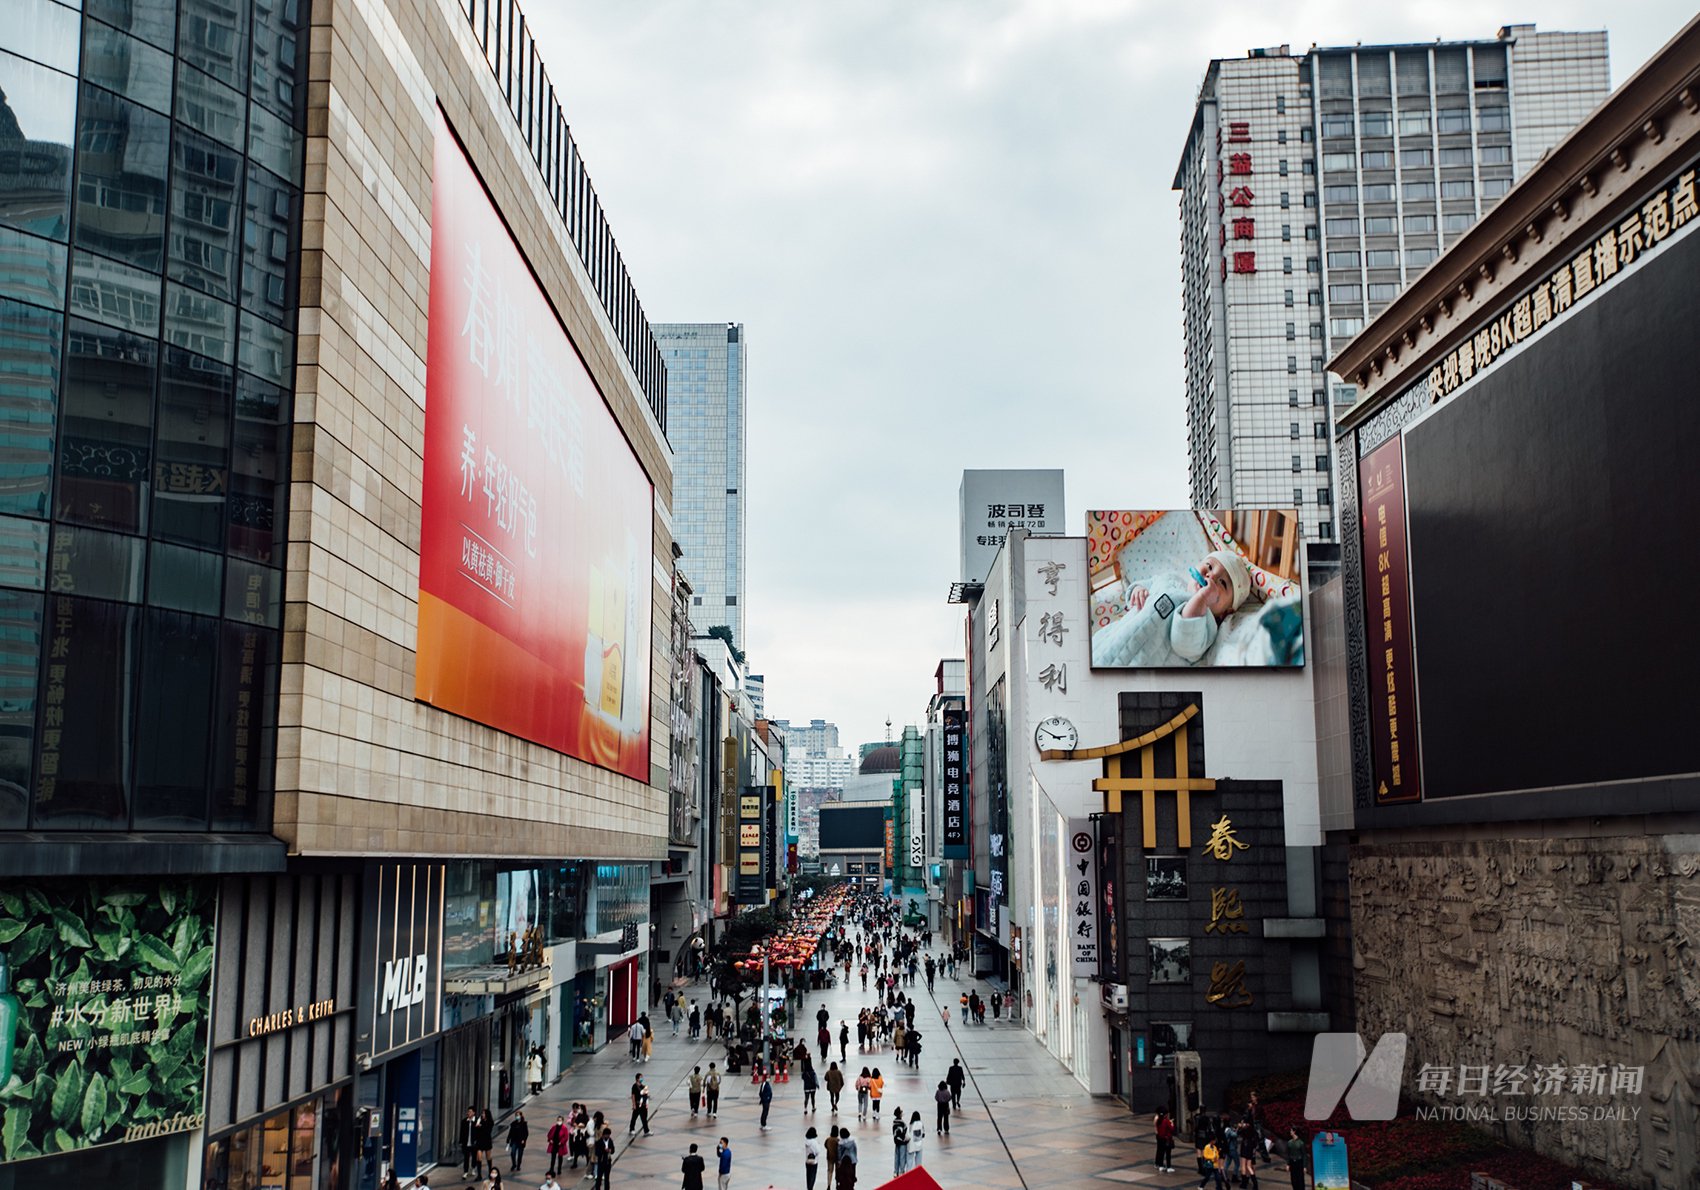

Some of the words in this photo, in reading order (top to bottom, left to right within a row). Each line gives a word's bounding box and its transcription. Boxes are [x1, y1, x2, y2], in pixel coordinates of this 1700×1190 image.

[1429, 169, 1700, 405] 央视春晚8K超高清直播示范点
[988, 504, 1044, 518] 波司登
[1038, 561, 1070, 696] 亨得利
[912, 836, 921, 864] GXG
[1202, 815, 1253, 1008] 春熙路
[381, 954, 428, 1014] MLB
[51, 993, 182, 1028] #水分新世界#
[250, 1009, 293, 1037] CHARLES
[298, 1006, 305, 1024] &
[309, 999, 334, 1021] KEITH
[58, 1039, 83, 1052] NEW
[124, 1111, 207, 1142] innisfree
